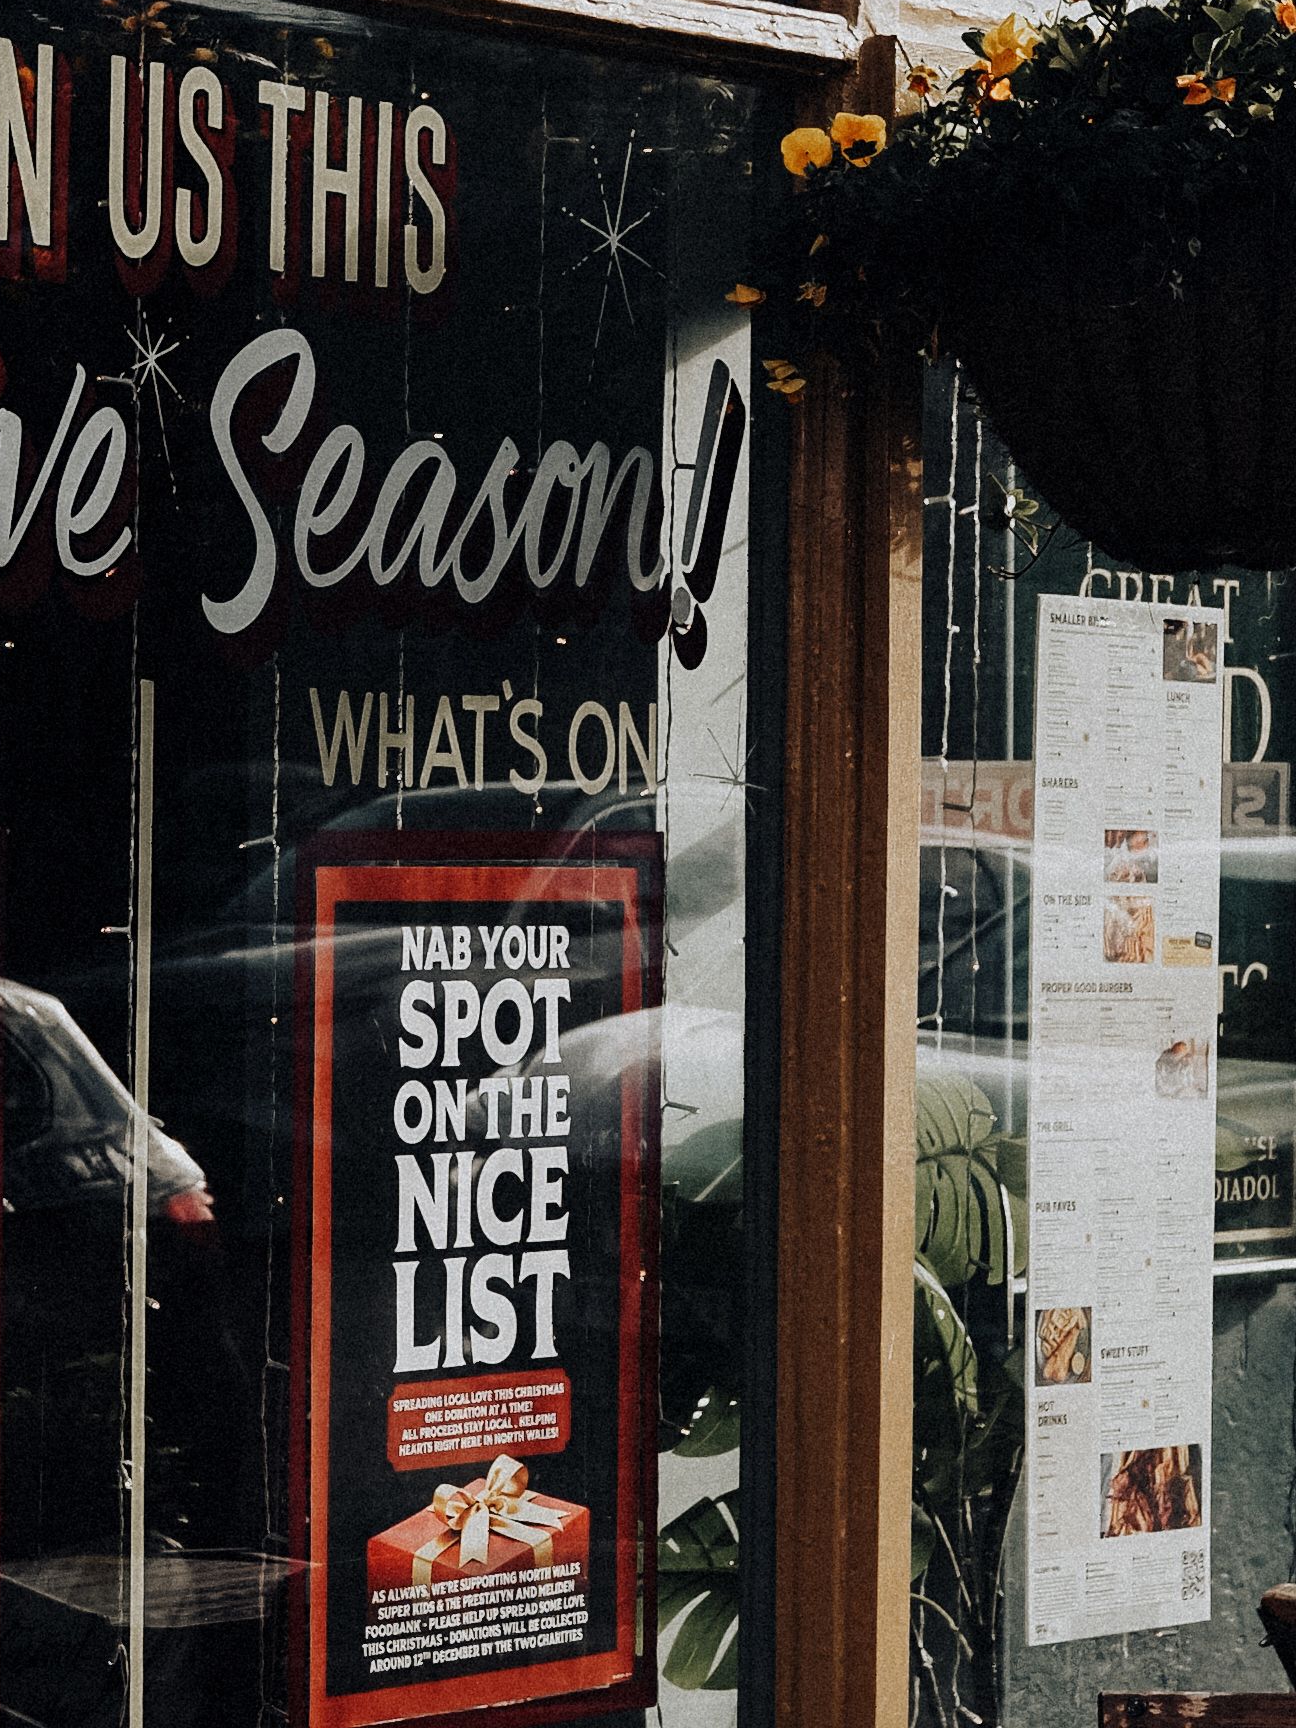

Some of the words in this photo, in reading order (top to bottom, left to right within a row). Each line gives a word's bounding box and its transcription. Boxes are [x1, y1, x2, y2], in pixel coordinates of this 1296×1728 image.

[109, 53, 224, 271] US
[254, 78, 448, 296] THIS
[200, 326, 730, 637] Season!
[1050, 613, 1086, 625] SMALLER
[1167, 692, 1190, 703] LUNCH
[308, 679, 546, 794] WHAT'S
[568, 699, 658, 794] ON
[1042, 777, 1078, 789] SHARERS
[1075, 895, 1092, 906] SIDE
[401, 925, 472, 971] NAB
[478, 924, 571, 970] YOUR
[1041, 983, 1073, 993] PROPER
[1074, 983, 1097, 993] GOOD
[1098, 983, 1133, 993] BURGERS
[399, 978, 571, 1068] SPOT
[393, 1079, 468, 1144] ON
[478, 1075, 571, 1140] THE
[394, 1146, 571, 1253] NICE
[1053, 1201, 1076, 1212] FAVES
[392, 1249, 571, 1372] LIST
[1101, 1347, 1126, 1359] SWEET
[1127, 1345, 1149, 1357] STUFF
[393, 1396, 442, 1413] SPREADING
[444, 1393, 470, 1406] LOCAL
[471, 1390, 493, 1404] LOVE
[494, 1387, 513, 1401] THIS
[515, 1382, 565, 1398] CHRISTMAS
[425, 1412, 443, 1424] ONE
[445, 1406, 487, 1422] DONATION
[488, 1403, 500, 1416] AT
[500, 1403, 508, 1414] A
[1038, 1401, 1054, 1412] HOT
[402, 1428, 419, 1441] ALL
[420, 1423, 463, 1439] PROCEEDS
[464, 1420, 484, 1434] STAY
[485, 1417, 513, 1431] LOCAL
[519, 1412, 556, 1427] HELPING
[1038, 1414, 1067, 1427] DRINKS
[399, 1441, 433, 1457] HEARTS
[434, 1438, 460, 1452] RIGHT
[461, 1436, 482, 1449] HERE
[483, 1434, 494, 1446] IN
[494, 1430, 524, 1445] NORTH
[372, 1590, 386, 1604] AS
[459, 1571, 517, 1591] SUPPORTING
[519, 1566, 552, 1584] NORTH
[552, 1562, 581, 1580] WALES
[365, 1620, 422, 1640] FOODBANK
[429, 1613, 462, 1631] PLEASE
[463, 1610, 485, 1625] HELP
[486, 1607, 499, 1622] UP
[500, 1601, 538, 1620] SPREAD
[539, 1598, 563, 1613] SOME
[563, 1594, 586, 1610] LOVE
[377, 1604, 410, 1621] SUPER
[412, 1600, 435, 1616] KIDS
[445, 1595, 462, 1612] THE
[462, 1588, 515, 1608] PRESTATYN
[516, 1584, 538, 1600] AND
[362, 1641, 385, 1658] THIS
[386, 1632, 443, 1654] CHRISTMAS
[450, 1623, 502, 1645] DONATIONS
[503, 1618, 527, 1635] WILL
[528, 1617, 540, 1632] BE
[540, 1610, 588, 1629] COLLECTED
[370, 1655, 411, 1674] AROUND
[433, 1644, 480, 1665] DECEMBER
[481, 1642, 493, 1656] BY
[495, 1638, 513, 1655] THE
[514, 1634, 537, 1651] TWO
[537, 1628, 583, 1648] CHARITIES
